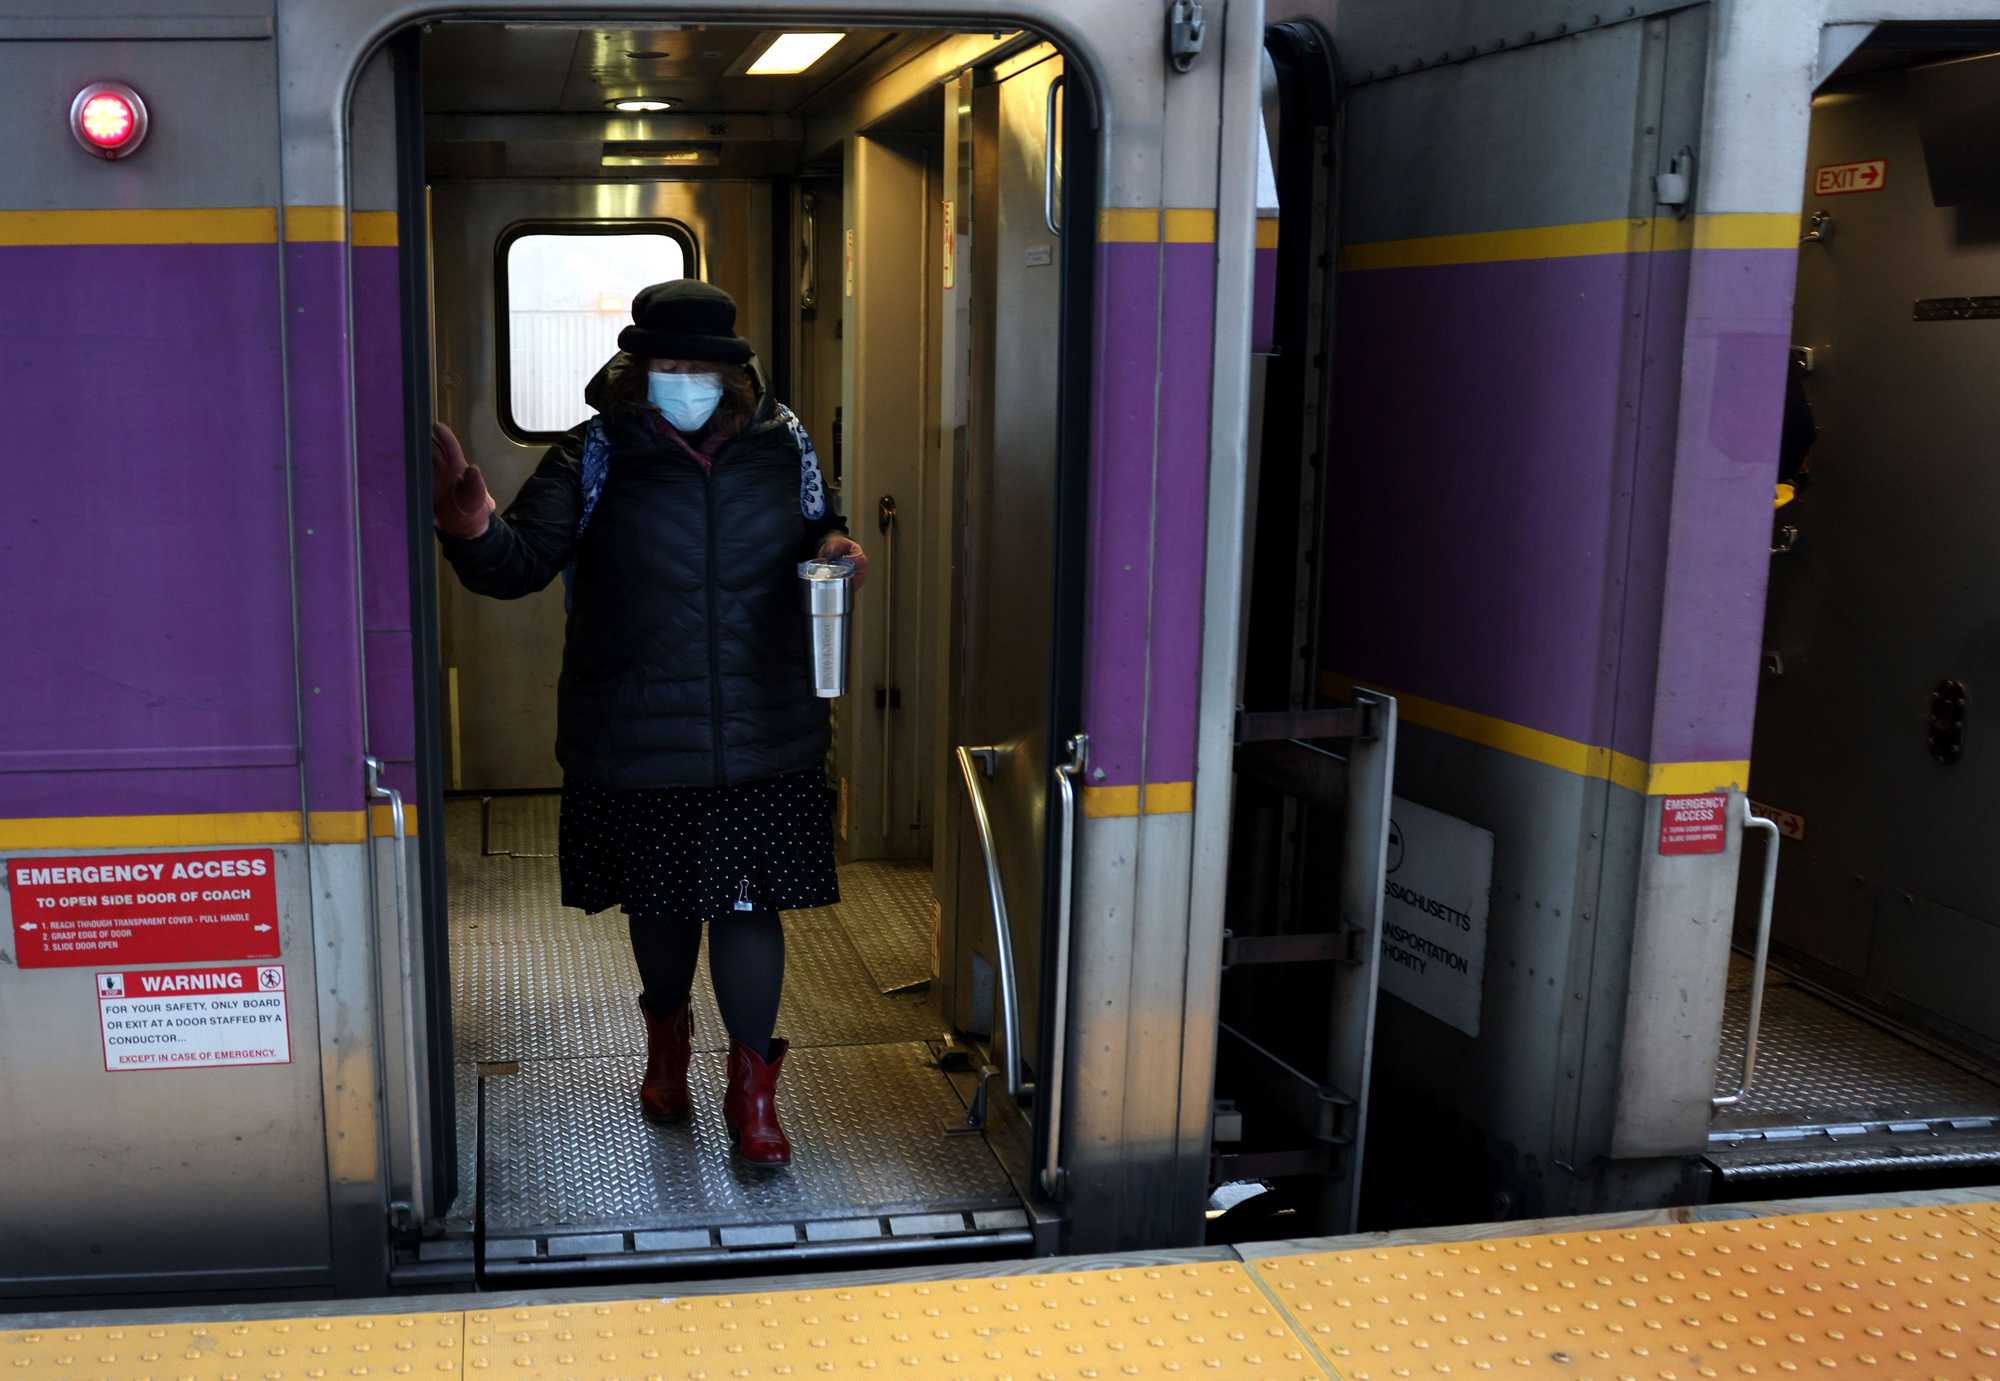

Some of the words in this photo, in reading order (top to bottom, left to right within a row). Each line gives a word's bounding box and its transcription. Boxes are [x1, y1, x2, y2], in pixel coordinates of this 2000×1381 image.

[1819, 168, 1857, 190] EXIT
[1664, 797, 1727, 810] EMERGENCY
[1675, 809, 1714, 822] ACCESS
[16, 863, 164, 886] EMERGENCY
[172, 859, 267, 880] ACCESS
[36, 897, 56, 908] TO
[59, 896, 98, 907] OPEN
[101, 894, 133, 906] SIDE
[137, 892, 177, 905] DOOR
[180, 891, 199, 903] OF
[202, 889, 251, 901] COACH
[1384, 880, 1472, 932] SSACHUSETTS
[42, 922, 49, 930] 1.
[50, 921, 76, 930] REACH
[77, 919, 112, 928] THROUGH
[114, 917, 166, 927] TRANSPARENT
[168, 916, 194, 925] COVER
[200, 914, 219, 924] PULL
[220, 913, 250, 922] HANDLE
[51, 932, 76, 940] GRASP
[78, 931, 97, 939] EDGE
[100, 931, 109, 939] OF
[110, 929, 132, 938] DOOR
[43, 944, 51, 952] 3.
[52, 943, 74, 951] SLIDE
[75, 942, 97, 950] DOOR
[97, 940, 118, 949] OPEN
[1383, 920, 1469, 975] NSPORTATION
[1382, 940, 1428, 975] HORITY
[141, 972, 243, 992] WARNING
[106, 1006, 127, 1014] FOR
[132, 1004, 161, 1013] YOUR
[165, 1002, 207, 1012] SAFETY,
[211, 1001, 238, 1010] ONLY
[243, 999, 280, 1009] BOARD
[107, 1021, 122, 1030] OR
[125, 1020, 148, 1029] EXIT
[151, 1019, 163, 1028] AT
[166, 1019, 173, 1027] A
[176, 1017, 207, 1026] DOOR
[209, 1015, 257, 1025] STAFFED
[259, 1014, 272, 1023] BY
[275, 1014, 282, 1022] A
[109, 1034, 187, 1045] CONDUCTOR...
[119, 1054, 156, 1064] EXCEPT
[159, 1053, 168, 1062] IN
[170, 1051, 197, 1061] CASE
[199, 1051, 212, 1060] OF
[214, 1049, 277, 1059] EMERGENCY.
